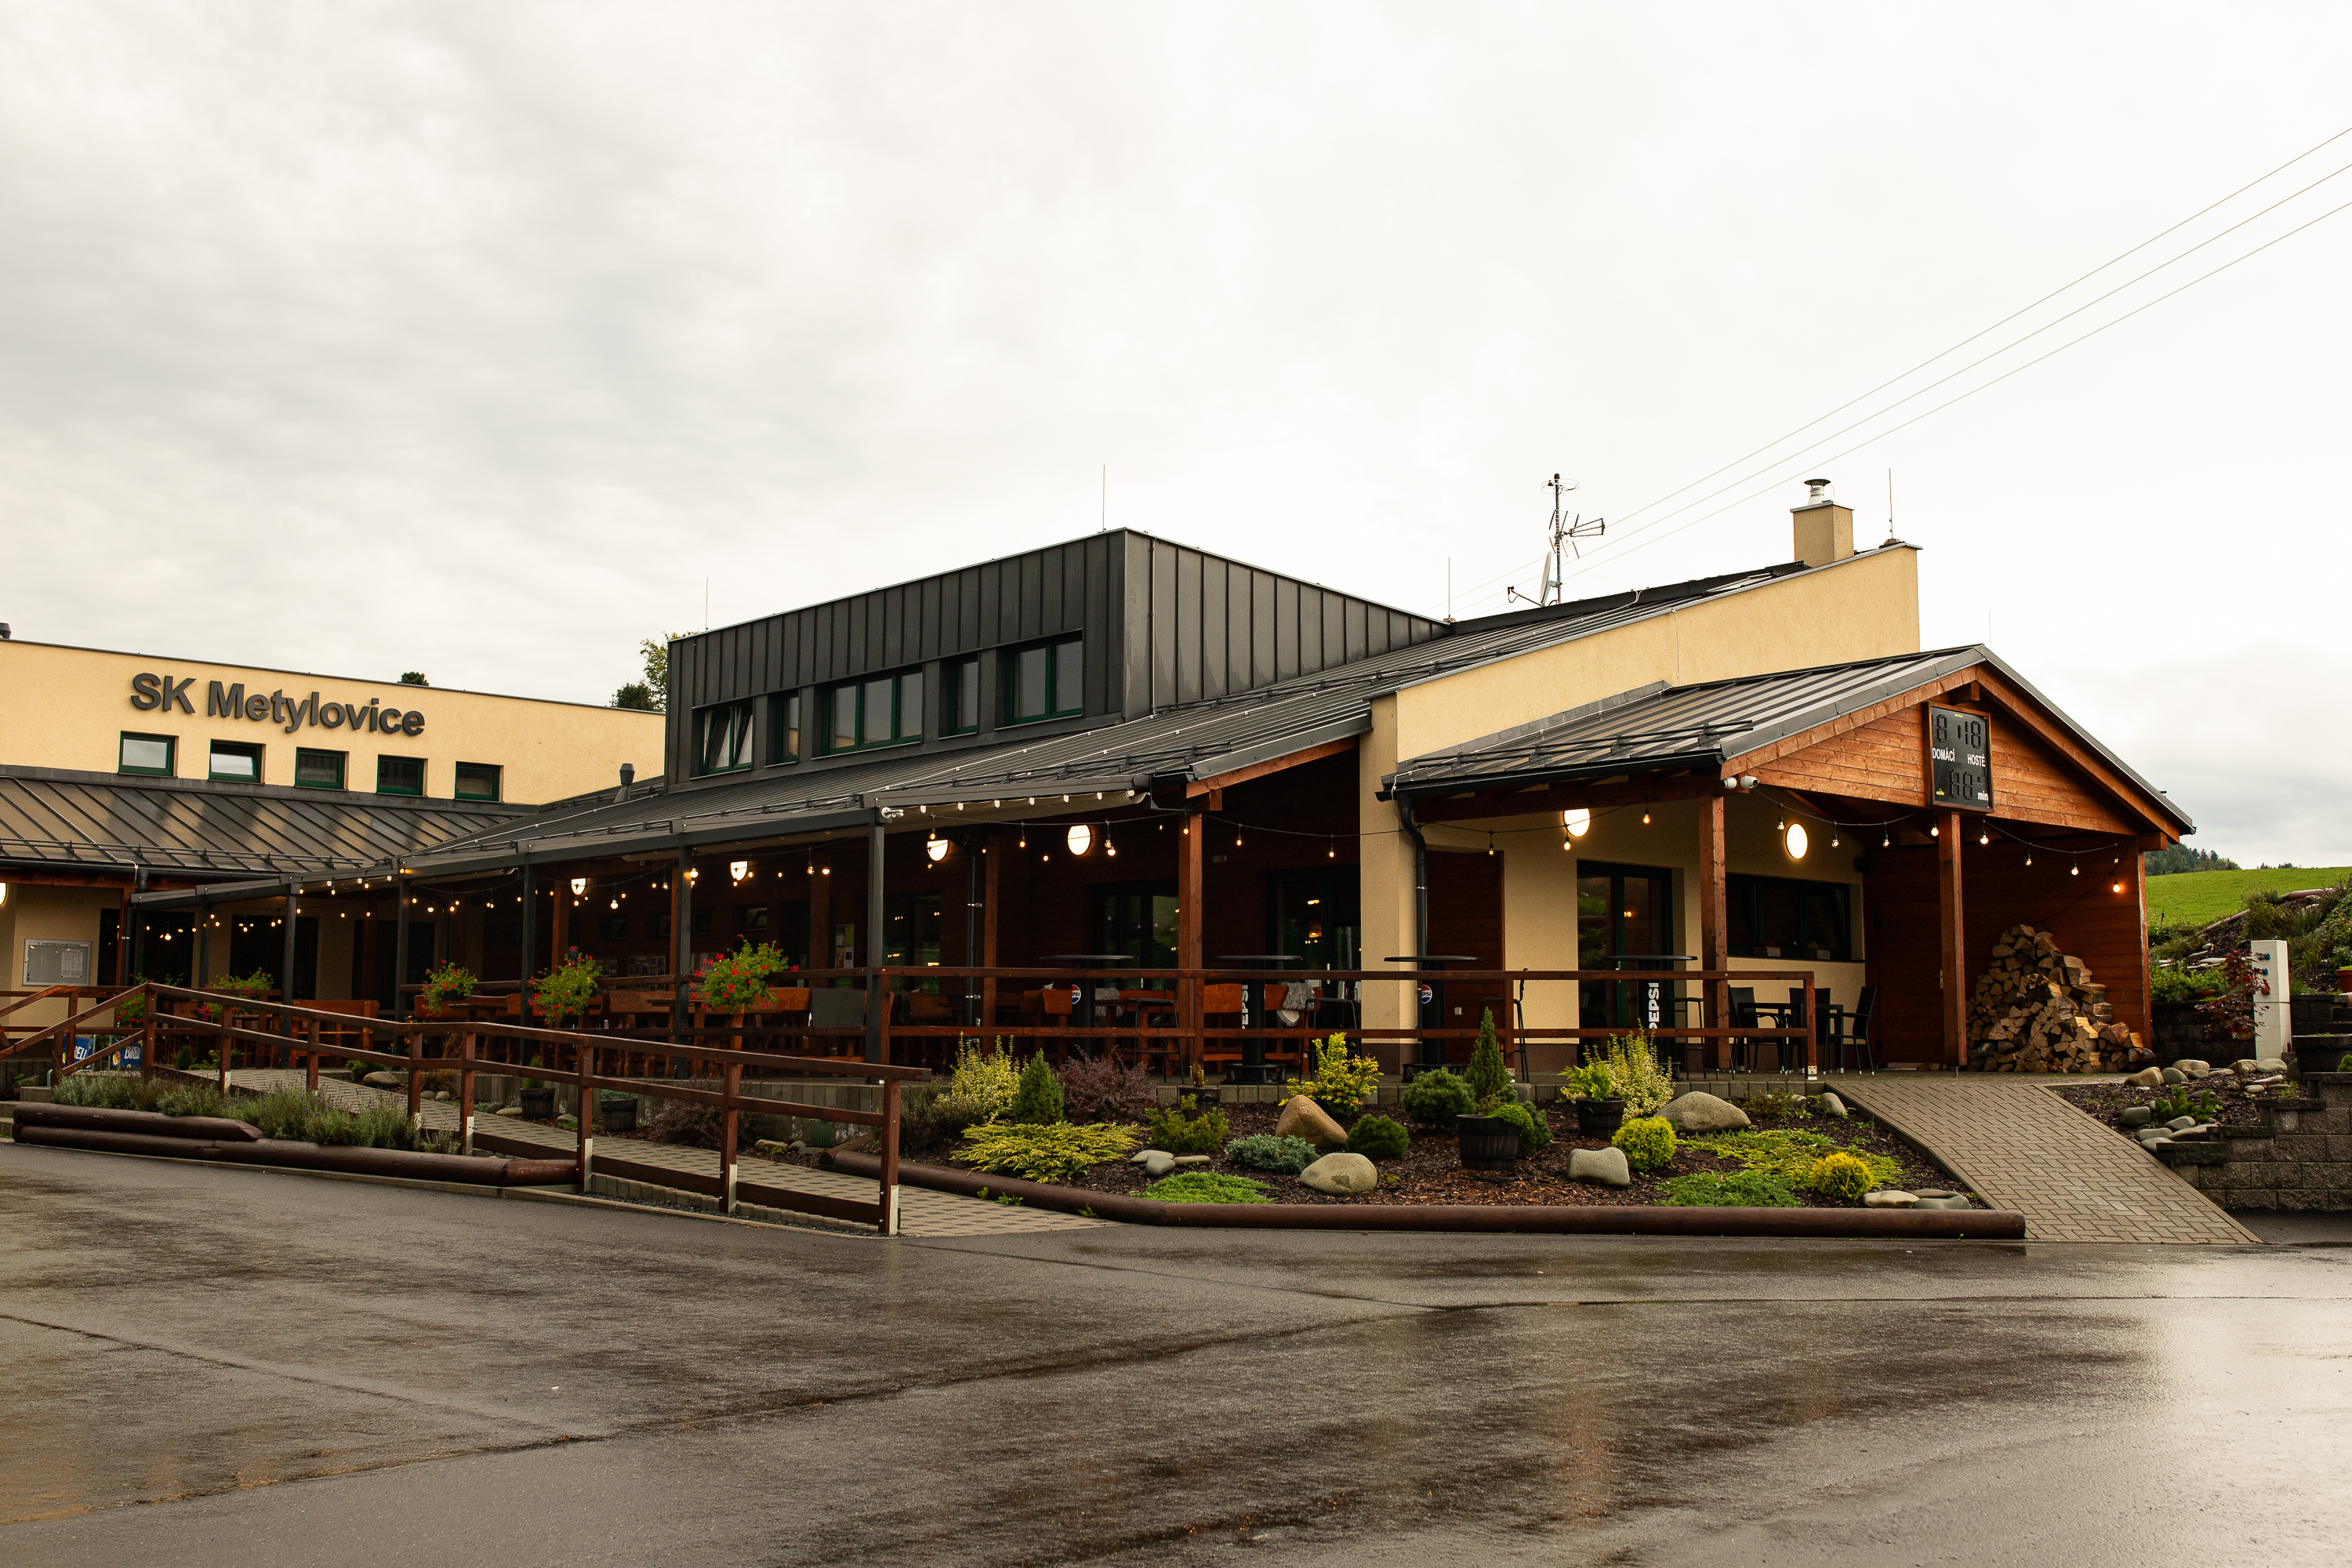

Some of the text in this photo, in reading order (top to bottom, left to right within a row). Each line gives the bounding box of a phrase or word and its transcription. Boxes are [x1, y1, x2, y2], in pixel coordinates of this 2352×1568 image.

[130, 673, 426, 736] SK Metylovice
[1932, 747, 1986, 768] DOMÁCÍ HOSTÉ
[1977, 790, 1989, 801] min
[74, 1045, 88, 1059] RELL
